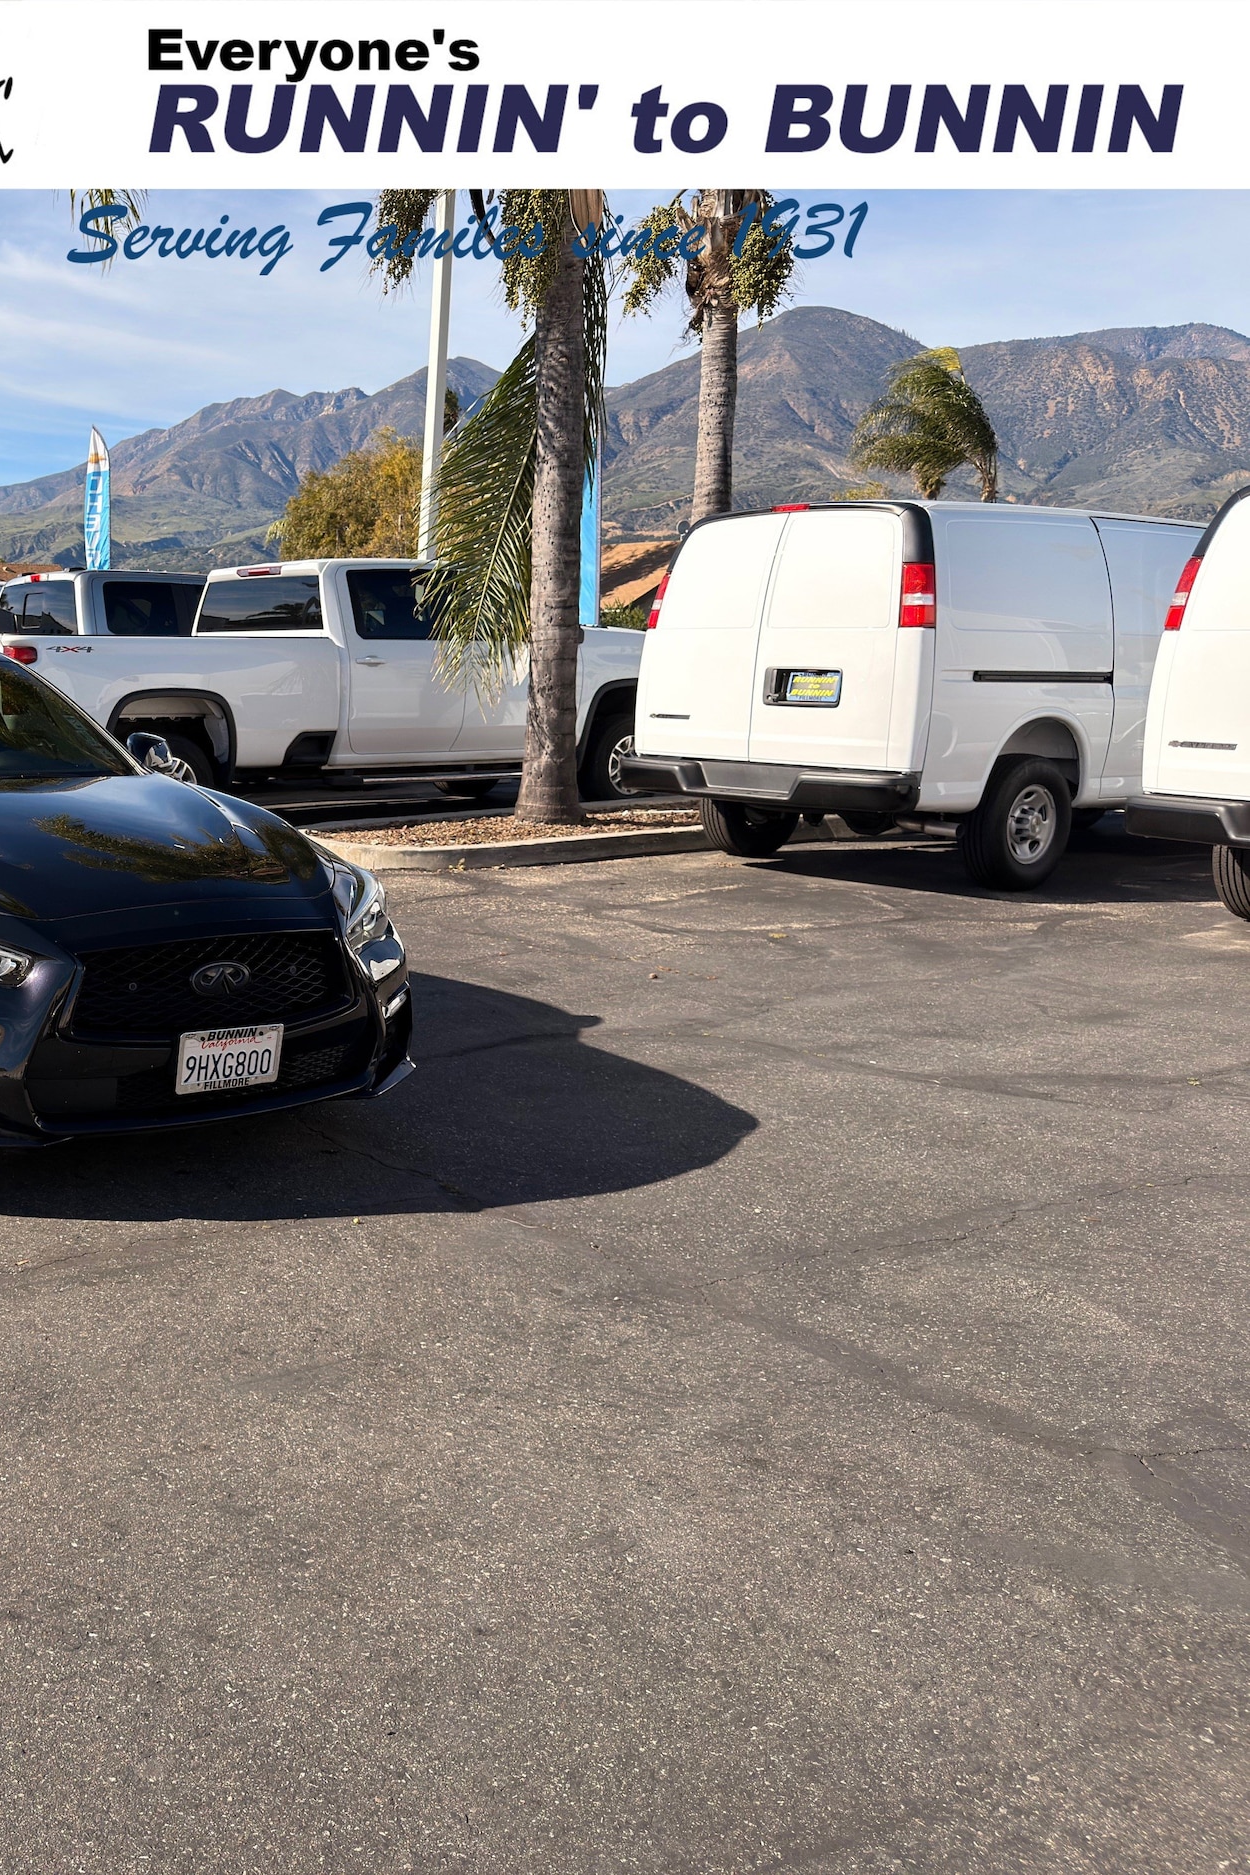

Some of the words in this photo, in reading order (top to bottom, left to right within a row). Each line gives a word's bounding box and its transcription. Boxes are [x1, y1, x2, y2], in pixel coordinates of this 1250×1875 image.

[790, 689, 834, 697] BUNNIN
[207, 1027, 258, 1042] BUNNIN
[201, 1036, 262, 1051] California
[183, 1048, 272, 1083] 9HXG800
[203, 1077, 251, 1090] FILLMORE
